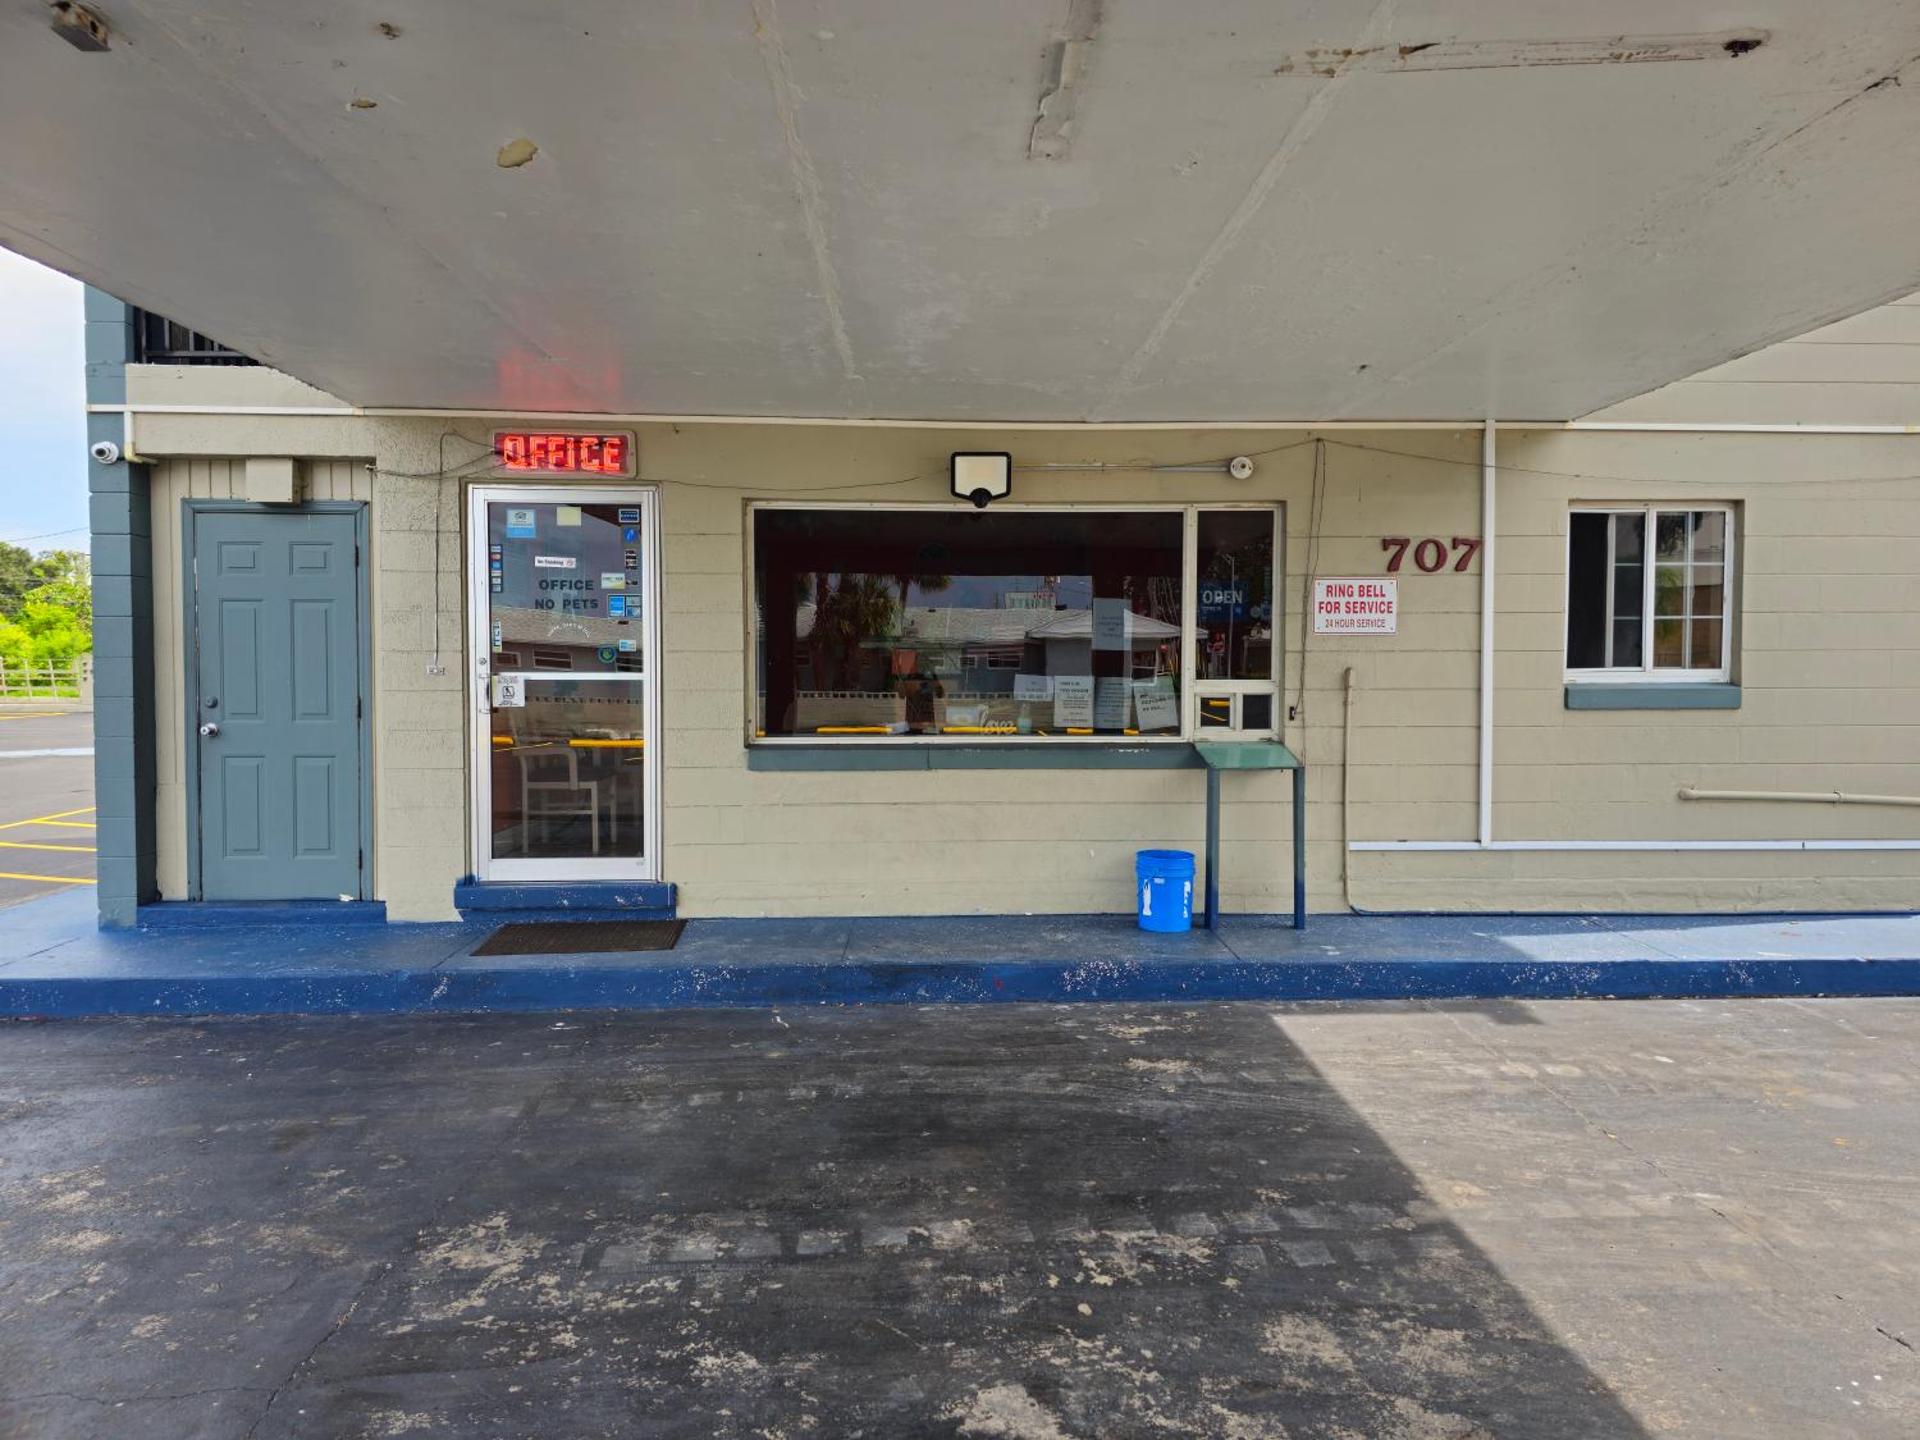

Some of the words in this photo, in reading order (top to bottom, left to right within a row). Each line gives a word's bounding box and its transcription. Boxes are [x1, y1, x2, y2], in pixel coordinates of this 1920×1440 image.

[503, 436, 621, 472] OFFICE
[1382, 538, 1482, 572] 707
[539, 579, 594, 590] OFFICE
[1326, 584, 1354, 598] RING
[1358, 584, 1386, 598] BELL
[535, 598, 555, 609] NO
[563, 598, 599, 609] PETS
[1202, 589, 1243, 605] OPEN
[1318, 600, 1341, 614] FOR
[1345, 600, 1394, 614] SERVICE
[1325, 618, 1334, 628] 24
[1335, 618, 1355, 628] HOUR
[1357, 618, 1386, 628] SERVICE
